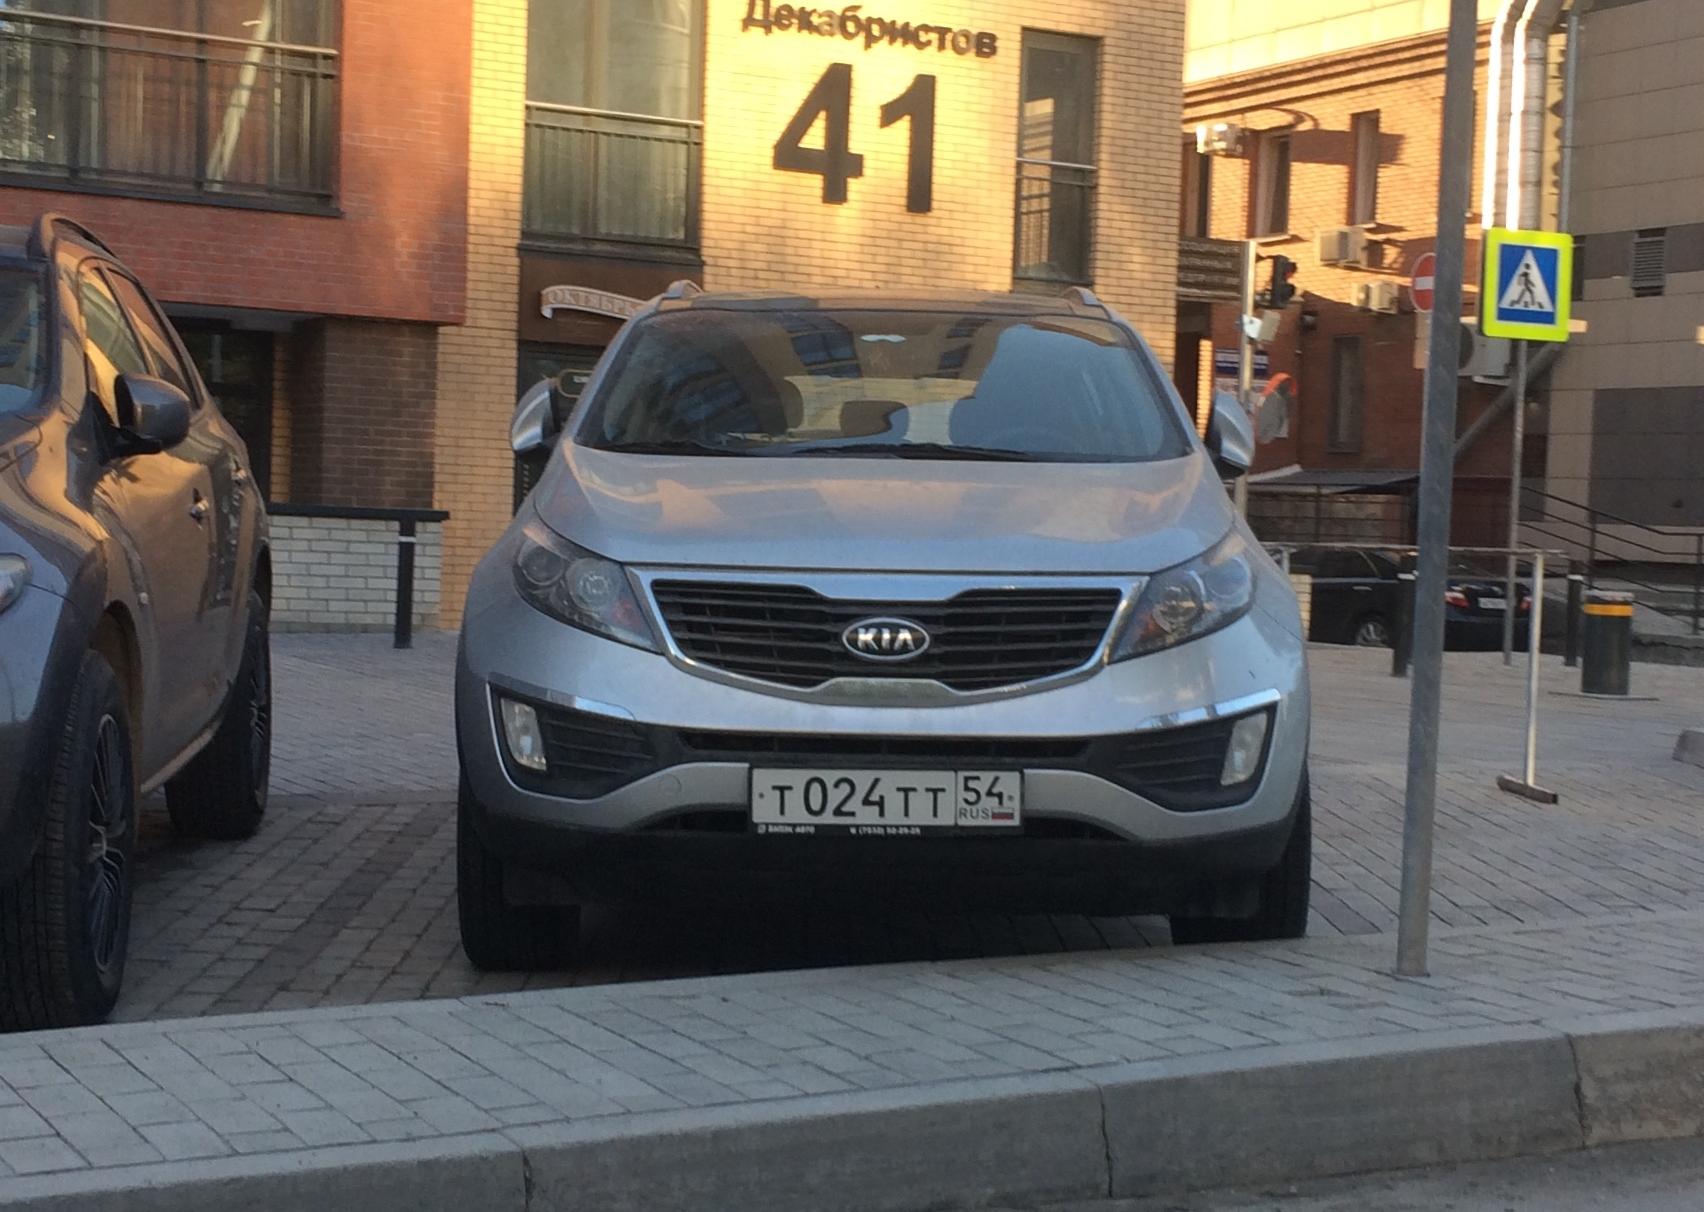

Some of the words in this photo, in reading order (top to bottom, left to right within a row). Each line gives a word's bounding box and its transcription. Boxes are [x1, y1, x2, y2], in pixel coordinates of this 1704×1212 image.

[742, 0, 998, 58] Декабристов
[772, 62, 937, 214] 41
[857, 627, 916, 651] KIA
[962, 775, 1004, 806] 54
[959, 807, 990, 820] RUS
